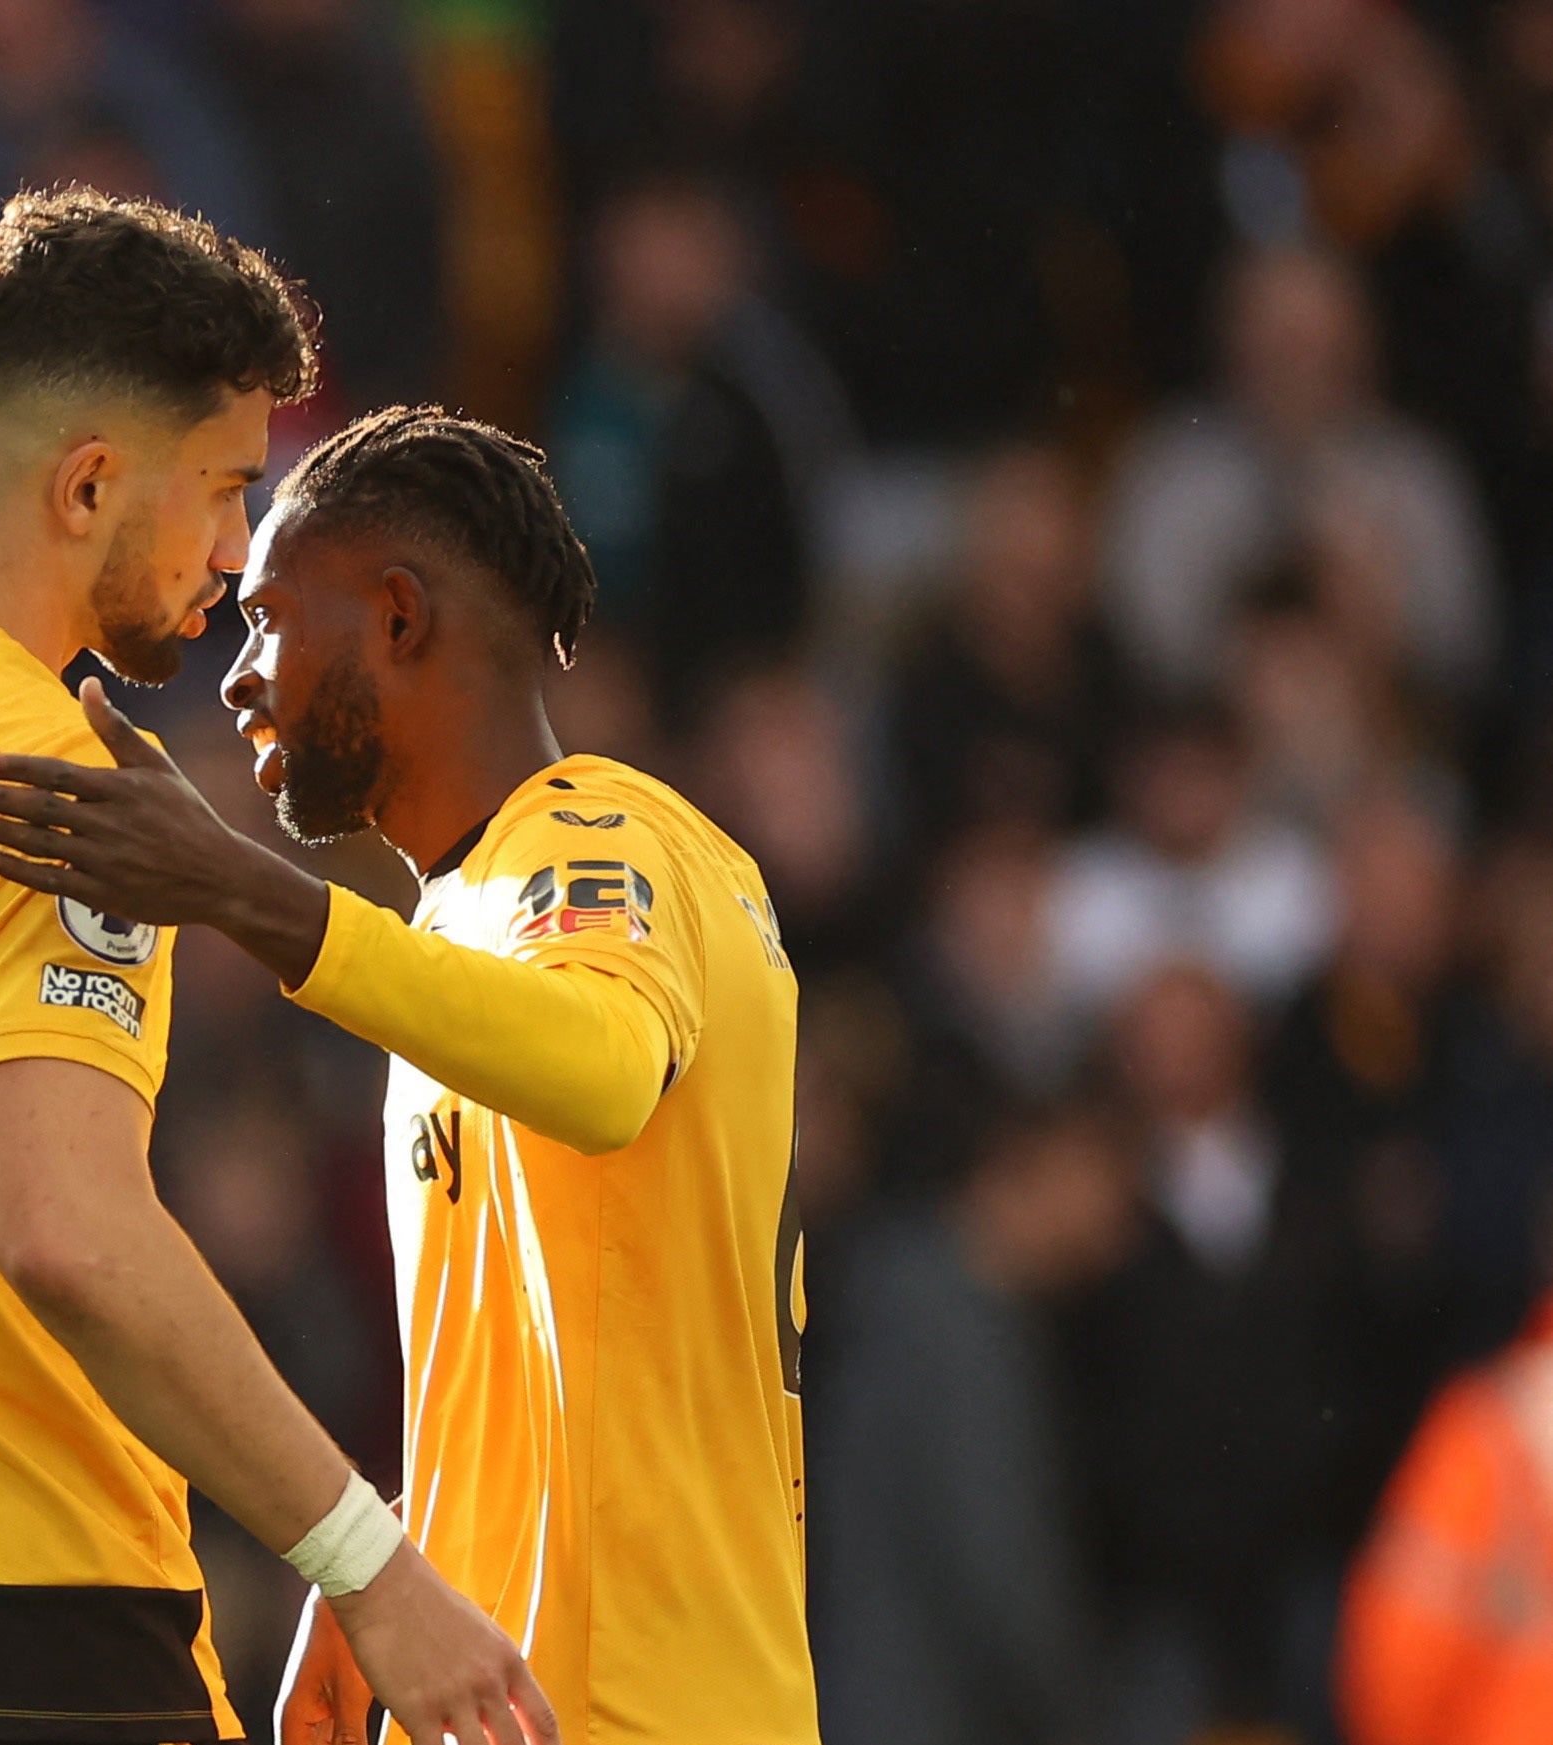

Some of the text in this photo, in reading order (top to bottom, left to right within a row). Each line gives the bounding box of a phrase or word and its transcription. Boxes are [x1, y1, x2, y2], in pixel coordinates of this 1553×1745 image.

[40, 984, 80, 1005] for
[44, 963, 137, 1016] No room
